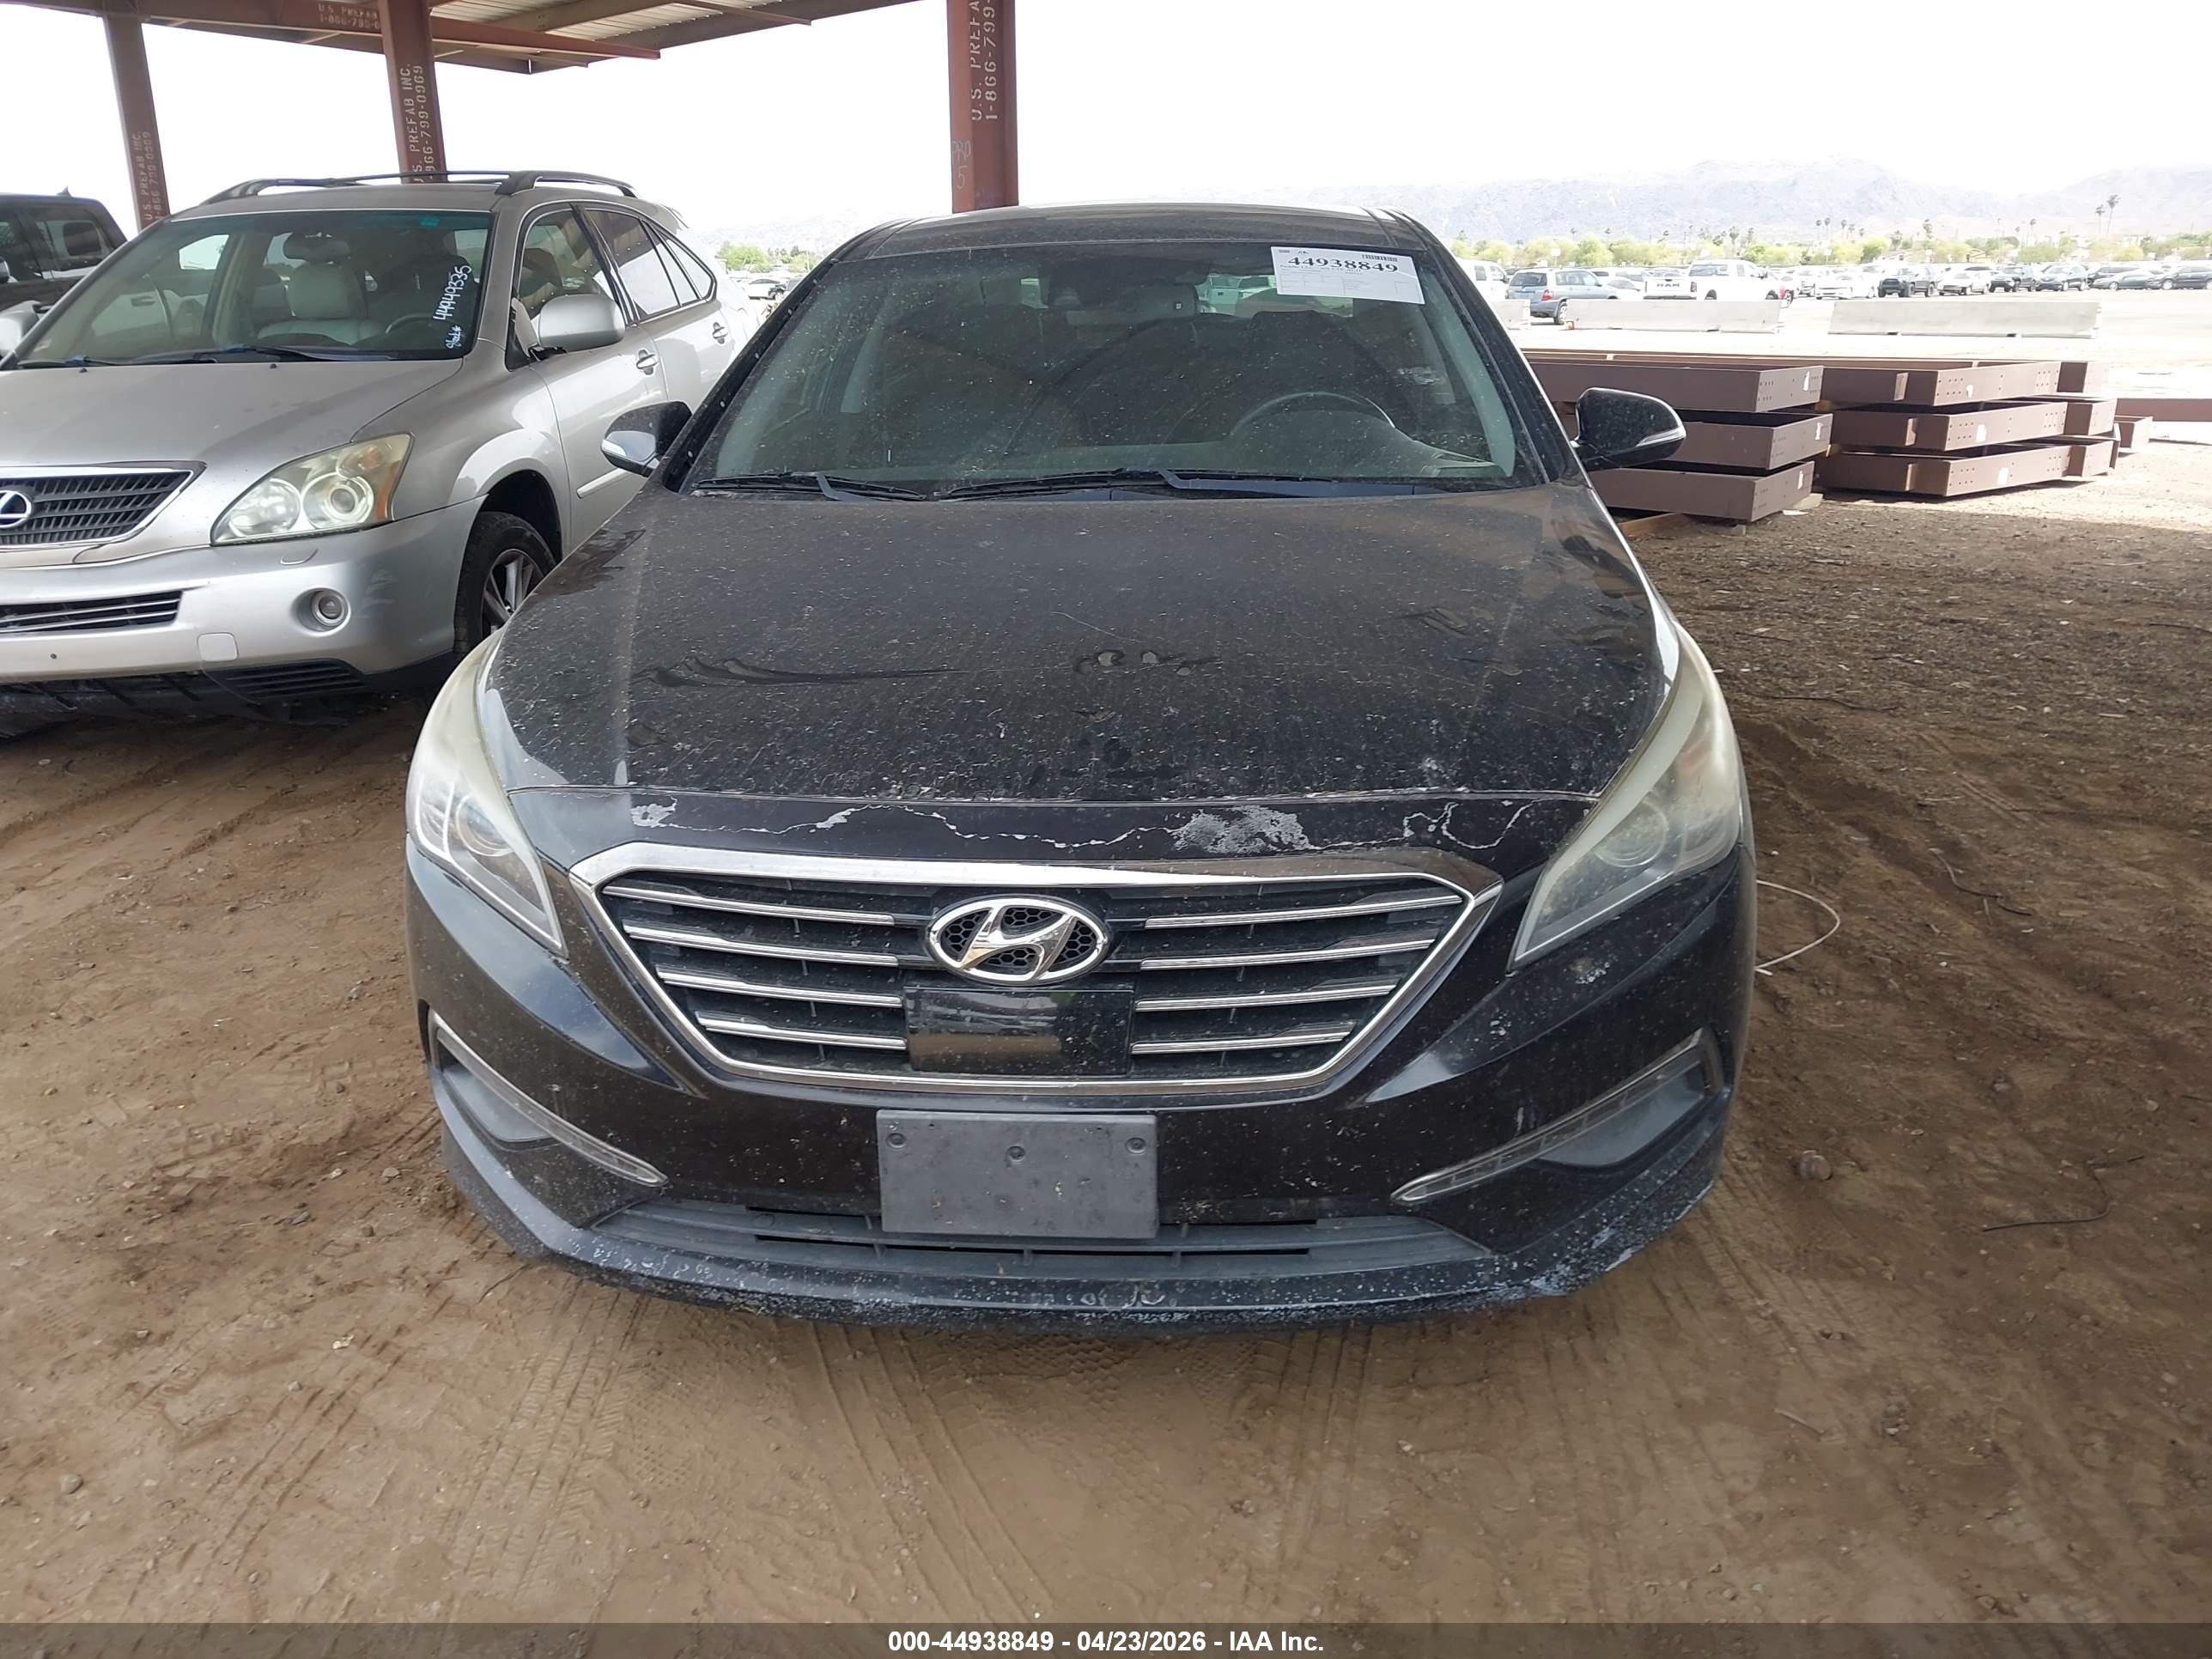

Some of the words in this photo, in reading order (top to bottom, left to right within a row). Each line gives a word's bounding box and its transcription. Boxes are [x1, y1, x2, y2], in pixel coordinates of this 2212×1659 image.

[400, 64, 413, 90] INC.
[971, 82, 982, 120] U.S.
[404, 98, 421, 152] PREFAB
[413, 65, 436, 179] -866-799-0969
[1288, 257, 1398, 273] 44938849
